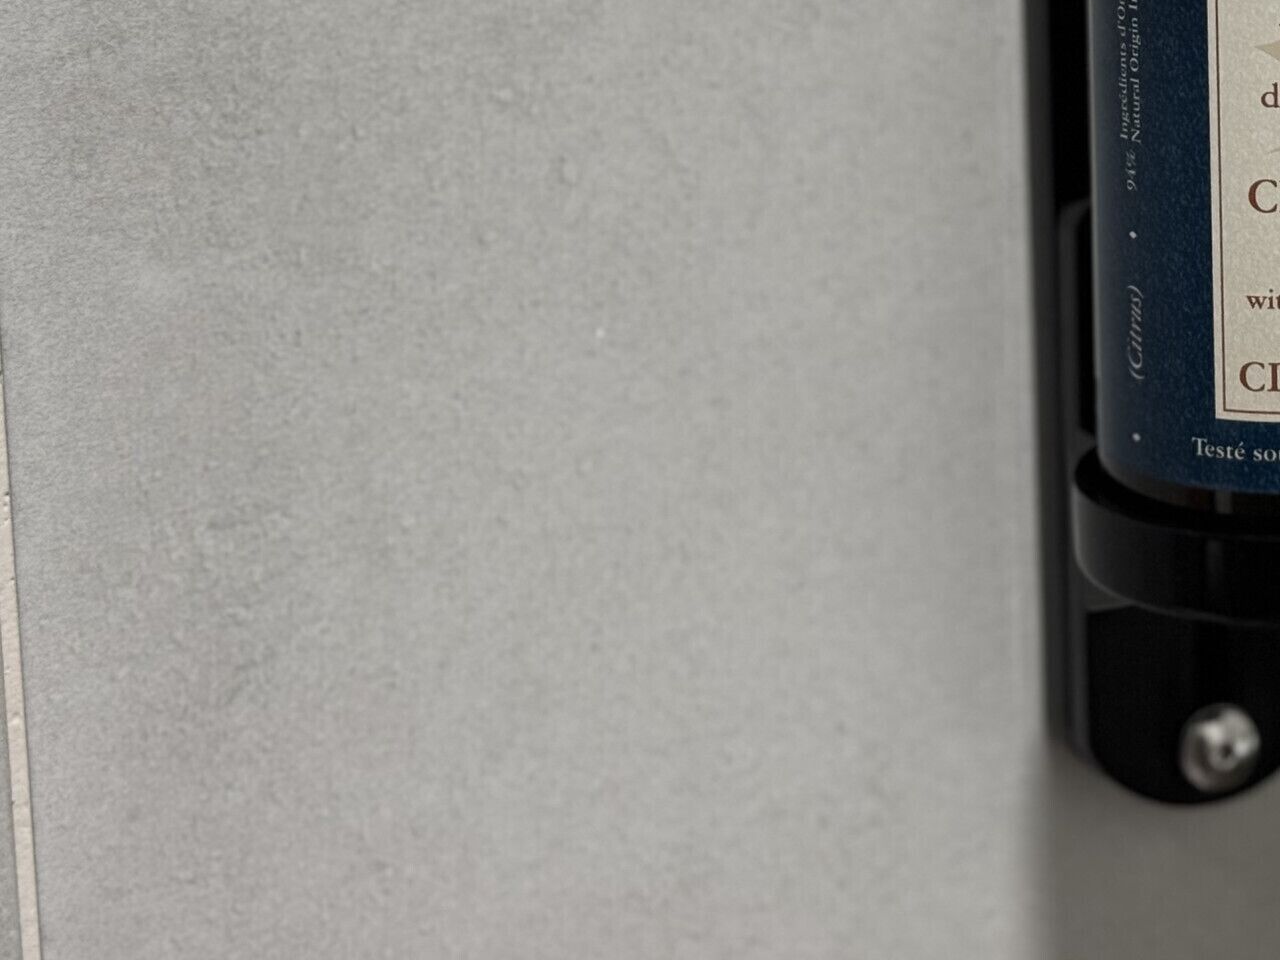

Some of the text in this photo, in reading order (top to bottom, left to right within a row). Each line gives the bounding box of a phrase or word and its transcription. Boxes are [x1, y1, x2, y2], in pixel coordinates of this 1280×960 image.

[1130, 16, 1141, 71] Origin
[1131, 76, 1141, 143] Natural
[1127, 285, 1144, 379] (Citrus)
[1192, 437, 1246, 460] Testé
